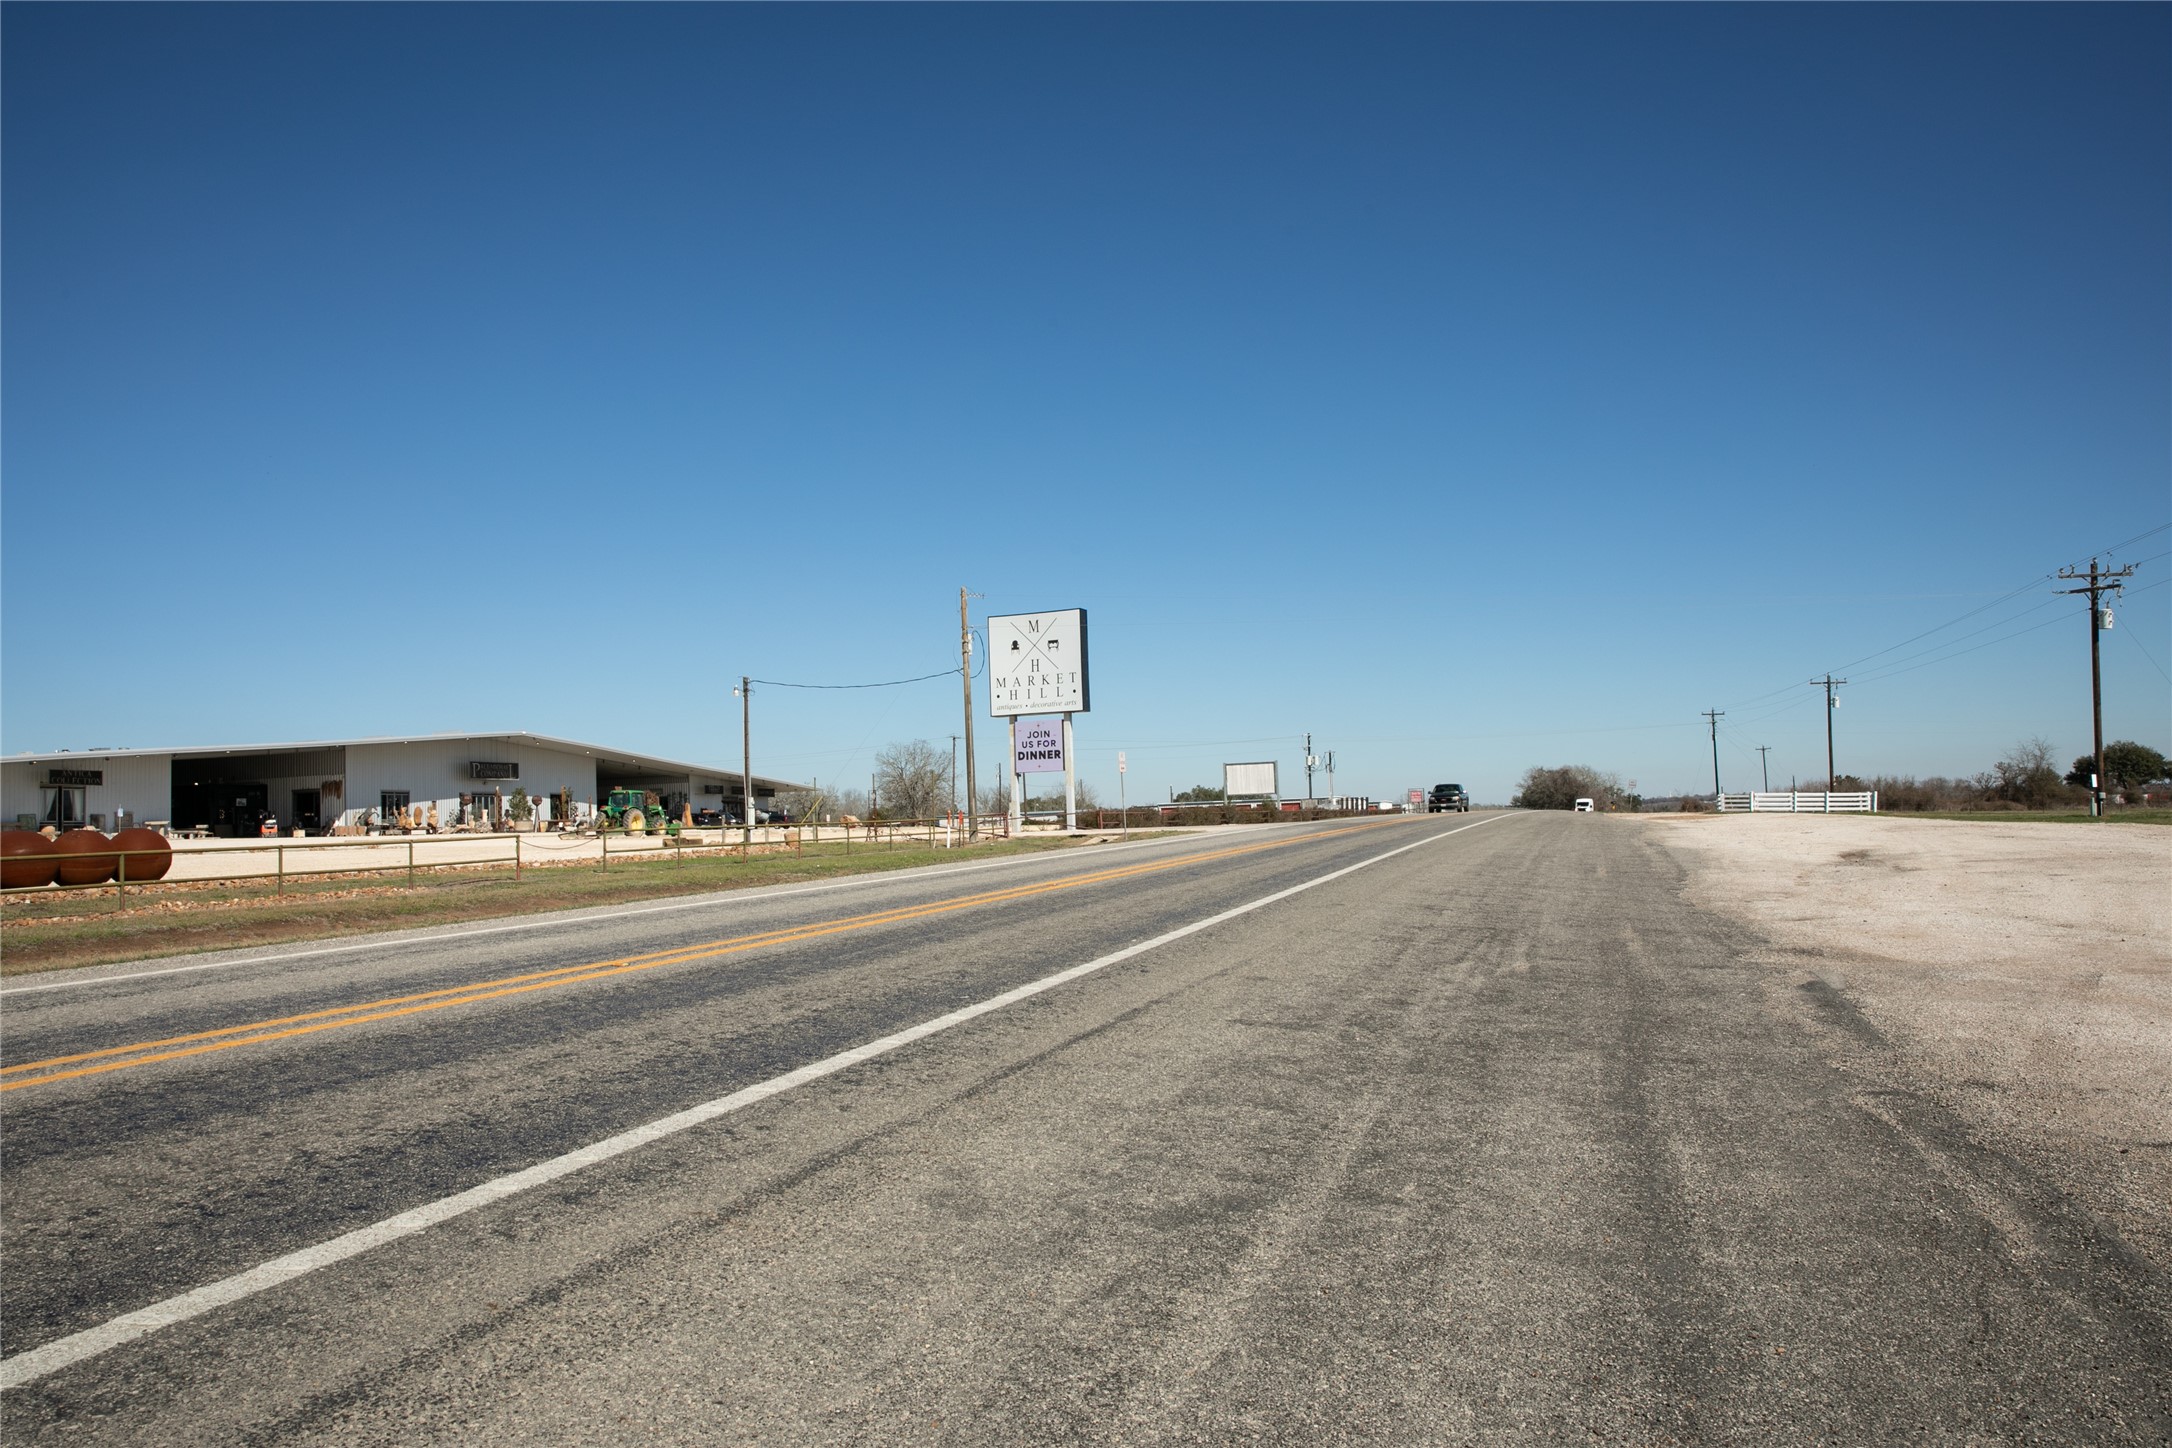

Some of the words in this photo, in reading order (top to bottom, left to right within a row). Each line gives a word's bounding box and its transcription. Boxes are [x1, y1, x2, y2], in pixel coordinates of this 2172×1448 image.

[1028, 619, 1039, 633] M
[1031, 659, 1040, 672] H
[996, 672, 1077, 688] MARKET
[1010, 687, 1064, 700] HILL
[1030, 700, 1063, 709] decorative
[1027, 730, 1050, 739] JOIN
[1021, 740, 1034, 749] US
[1037, 740, 1057, 748] FOR
[1017, 750, 1062, 761] DINNER
